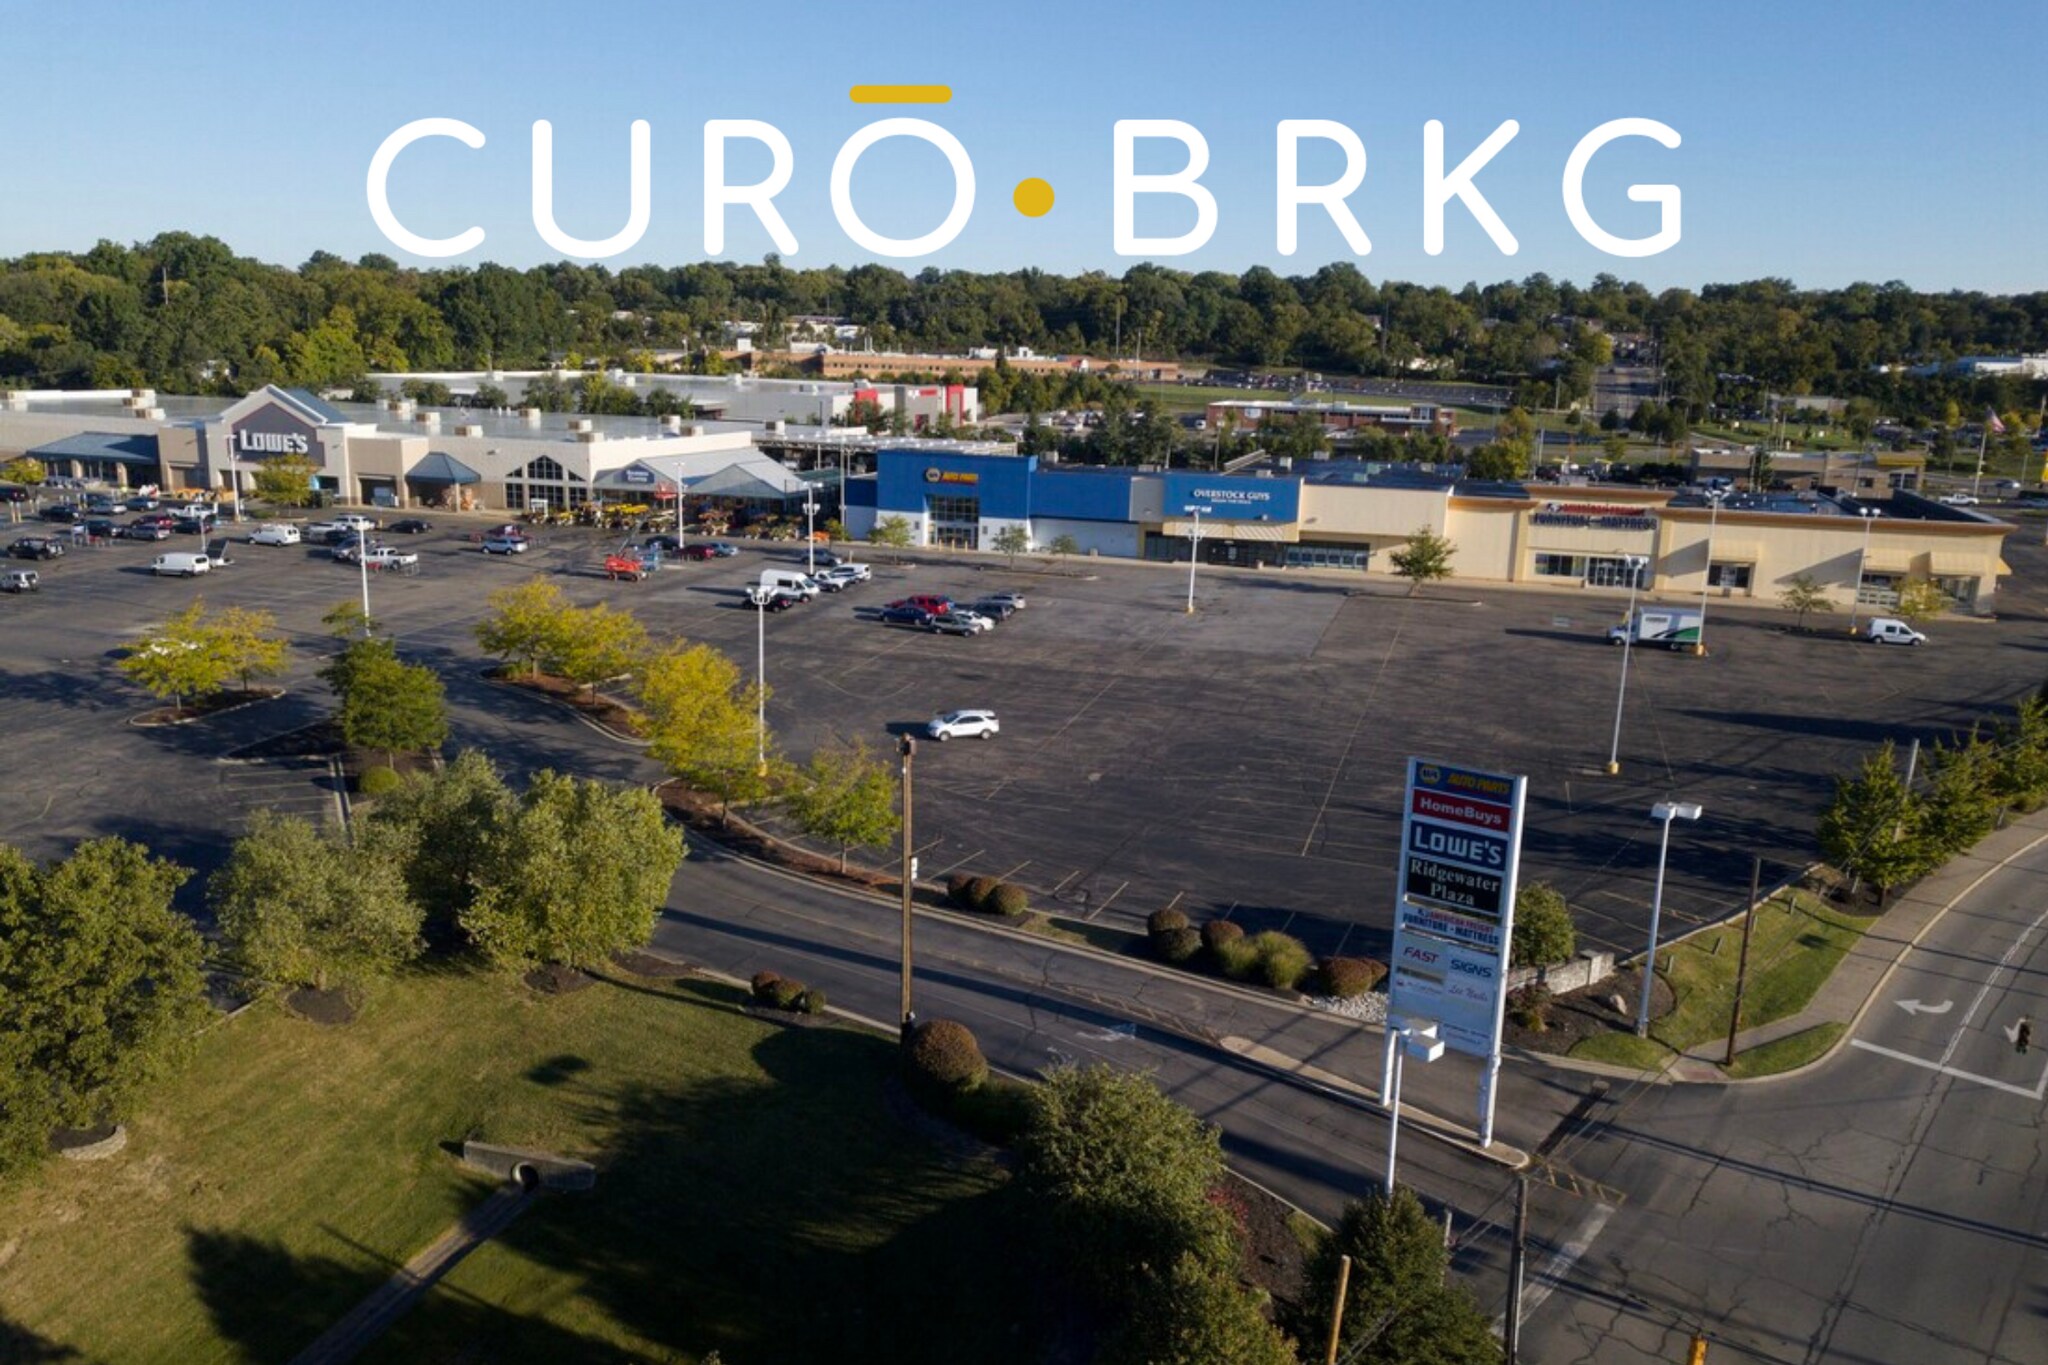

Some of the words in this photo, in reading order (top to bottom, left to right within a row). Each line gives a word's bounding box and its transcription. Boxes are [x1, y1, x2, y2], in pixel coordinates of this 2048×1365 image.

[240, 429, 309, 454] LOWE'S
[1193, 488, 1246, 499] OVERSTOCK
[1247, 491, 1271, 501] GUYS
[1420, 797, 1503, 825] HomeBuys
[1415, 826, 1502, 865] LOWE'S
[1410, 858, 1500, 892] Ridgewater
[1431, 883, 1475, 906] Plaza
[1403, 913, 1448, 933] FURNITURE
[1455, 925, 1499, 945] MATTRESS
[1403, 946, 1440, 964] FAST
[1450, 959, 1492, 978] SIGNS
